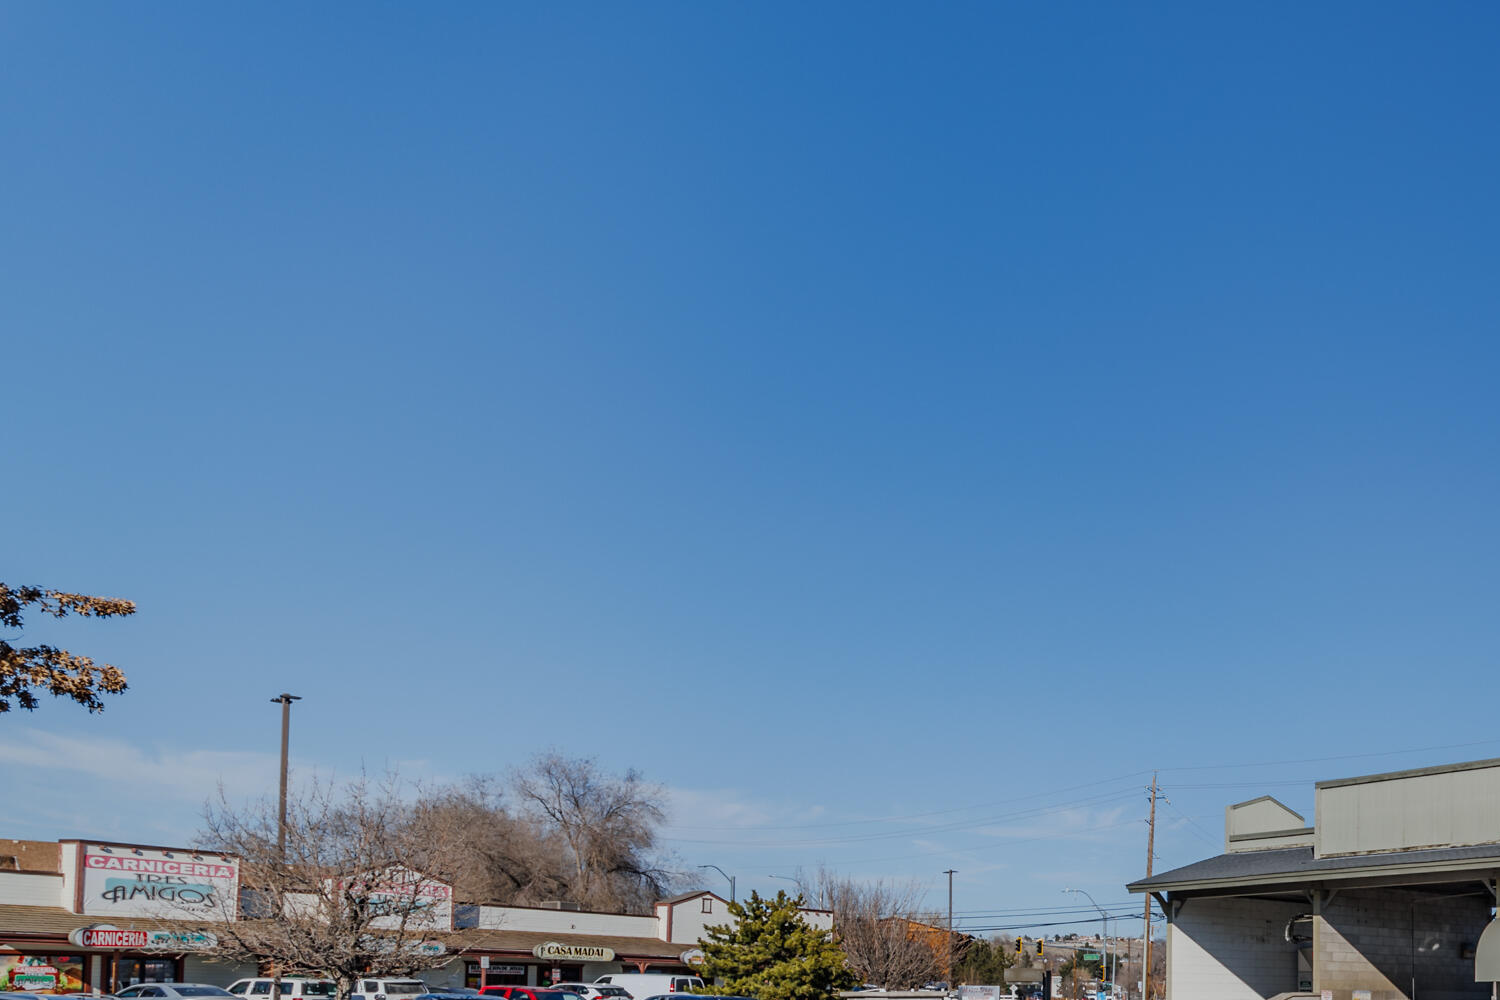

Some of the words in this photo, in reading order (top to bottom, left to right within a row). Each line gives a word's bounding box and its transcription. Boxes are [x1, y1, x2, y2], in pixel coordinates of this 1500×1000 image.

[88, 856, 231, 877] CARNICERIA
[135, 873, 187, 885] TRES
[102, 886, 216, 908] AMIGOS
[83, 931, 145, 946] CARNICERIA
[548, 946, 572, 955] CASA
[574, 947, 604, 957] MADAI
